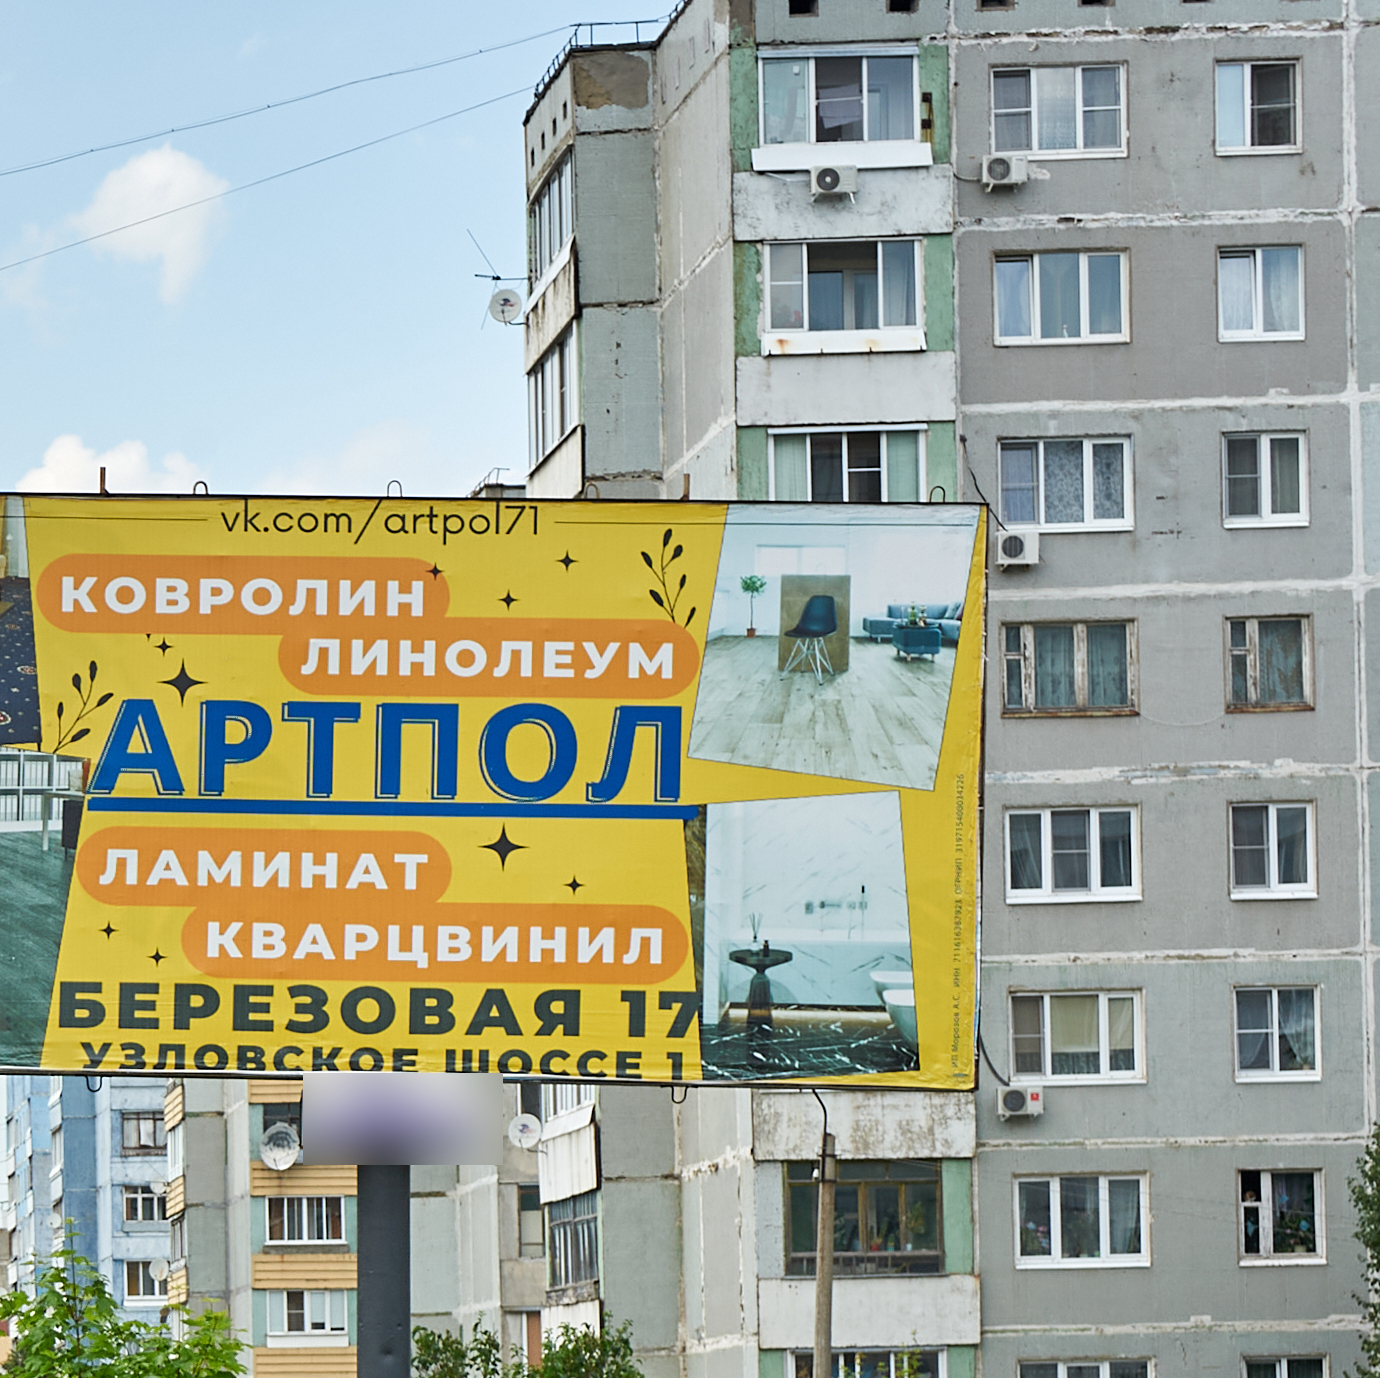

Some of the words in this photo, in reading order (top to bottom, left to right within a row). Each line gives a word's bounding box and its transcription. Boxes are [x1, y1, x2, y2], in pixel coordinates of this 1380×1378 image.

[220, 500, 540, 545] vk.com/artpol71
[61, 576, 425, 617] КОВРОЛИН
[300, 638, 674, 680] ЛИНОЛЕУМ
[84, 699, 682, 803] АРТПОЛ
[99, 848, 428, 891] ЛАМИНАТ
[205, 920, 664, 969] КВАРЦВИНИЛ
[952, 968, 961, 988] ИНН
[57, 980, 582, 1037] БЕРЕЗОВАЯ
[619, 988, 702, 1039] 17
[951, 1012, 961, 1053] Морозов
[80, 1041, 420, 1073] УЗЛОВСКОЕ
[444, 1048, 643, 1079] ШОССЕ
[666, 1051, 684, 1081] 1
